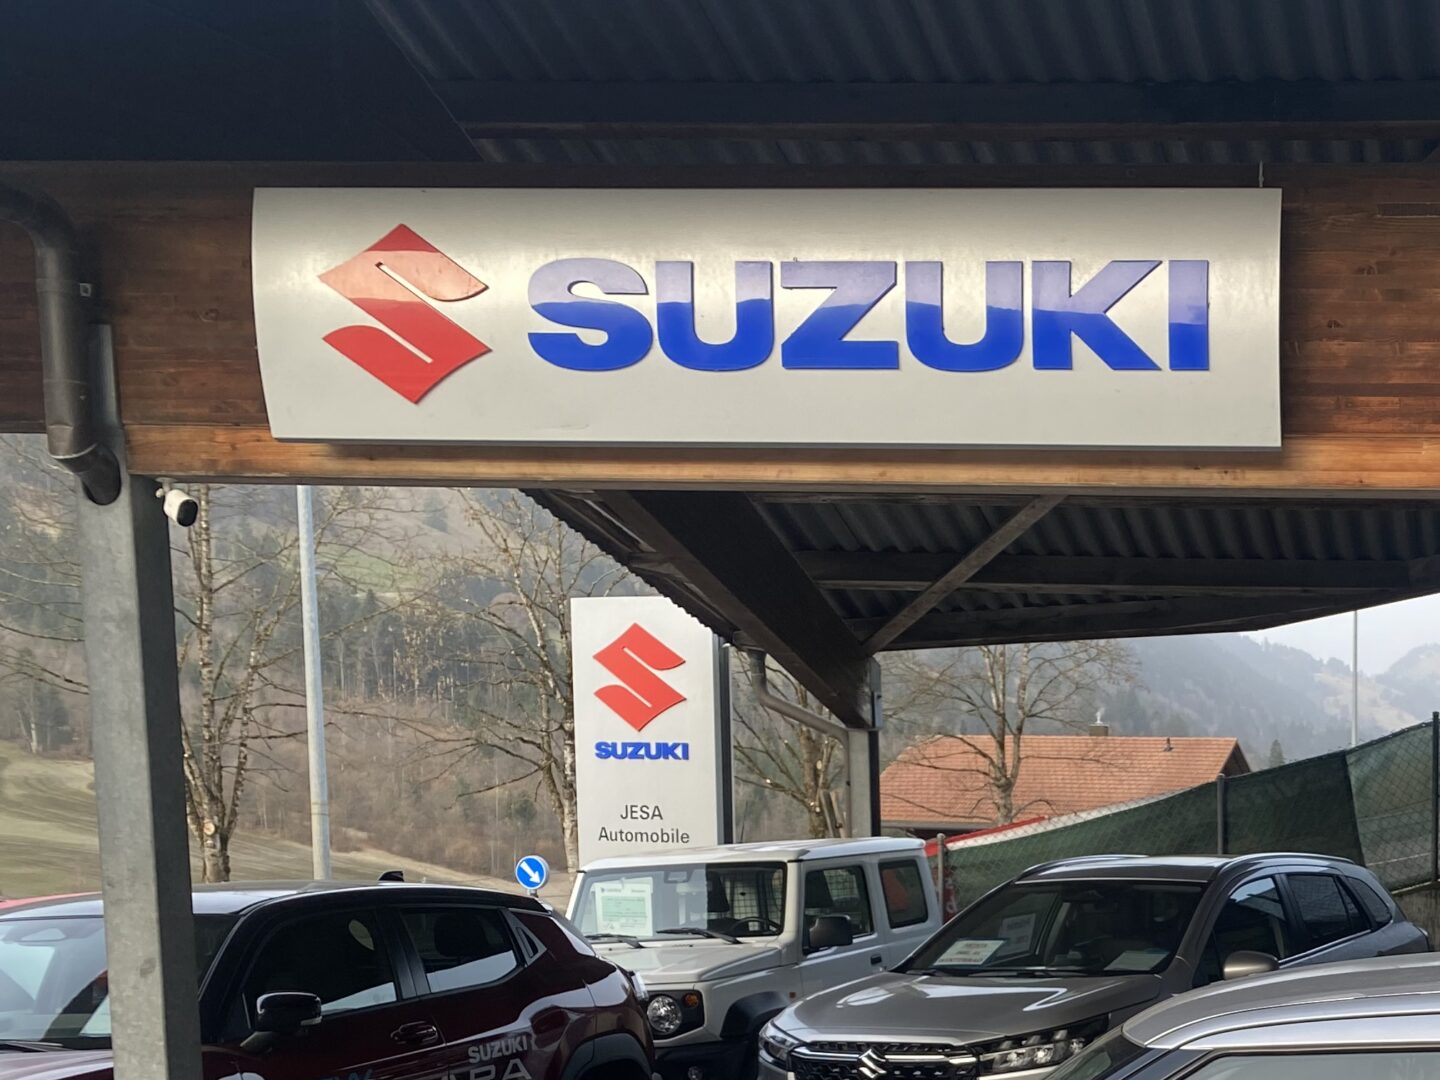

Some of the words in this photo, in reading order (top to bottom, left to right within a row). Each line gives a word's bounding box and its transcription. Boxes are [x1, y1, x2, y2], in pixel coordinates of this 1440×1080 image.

[528, 257, 1209, 372] SUZUKI
[594, 741, 690, 760] SUZUKI
[620, 804, 664, 820] JESA
[598, 826, 690, 843] Automobile
[467, 1034, 529, 1064] SUZUKI
